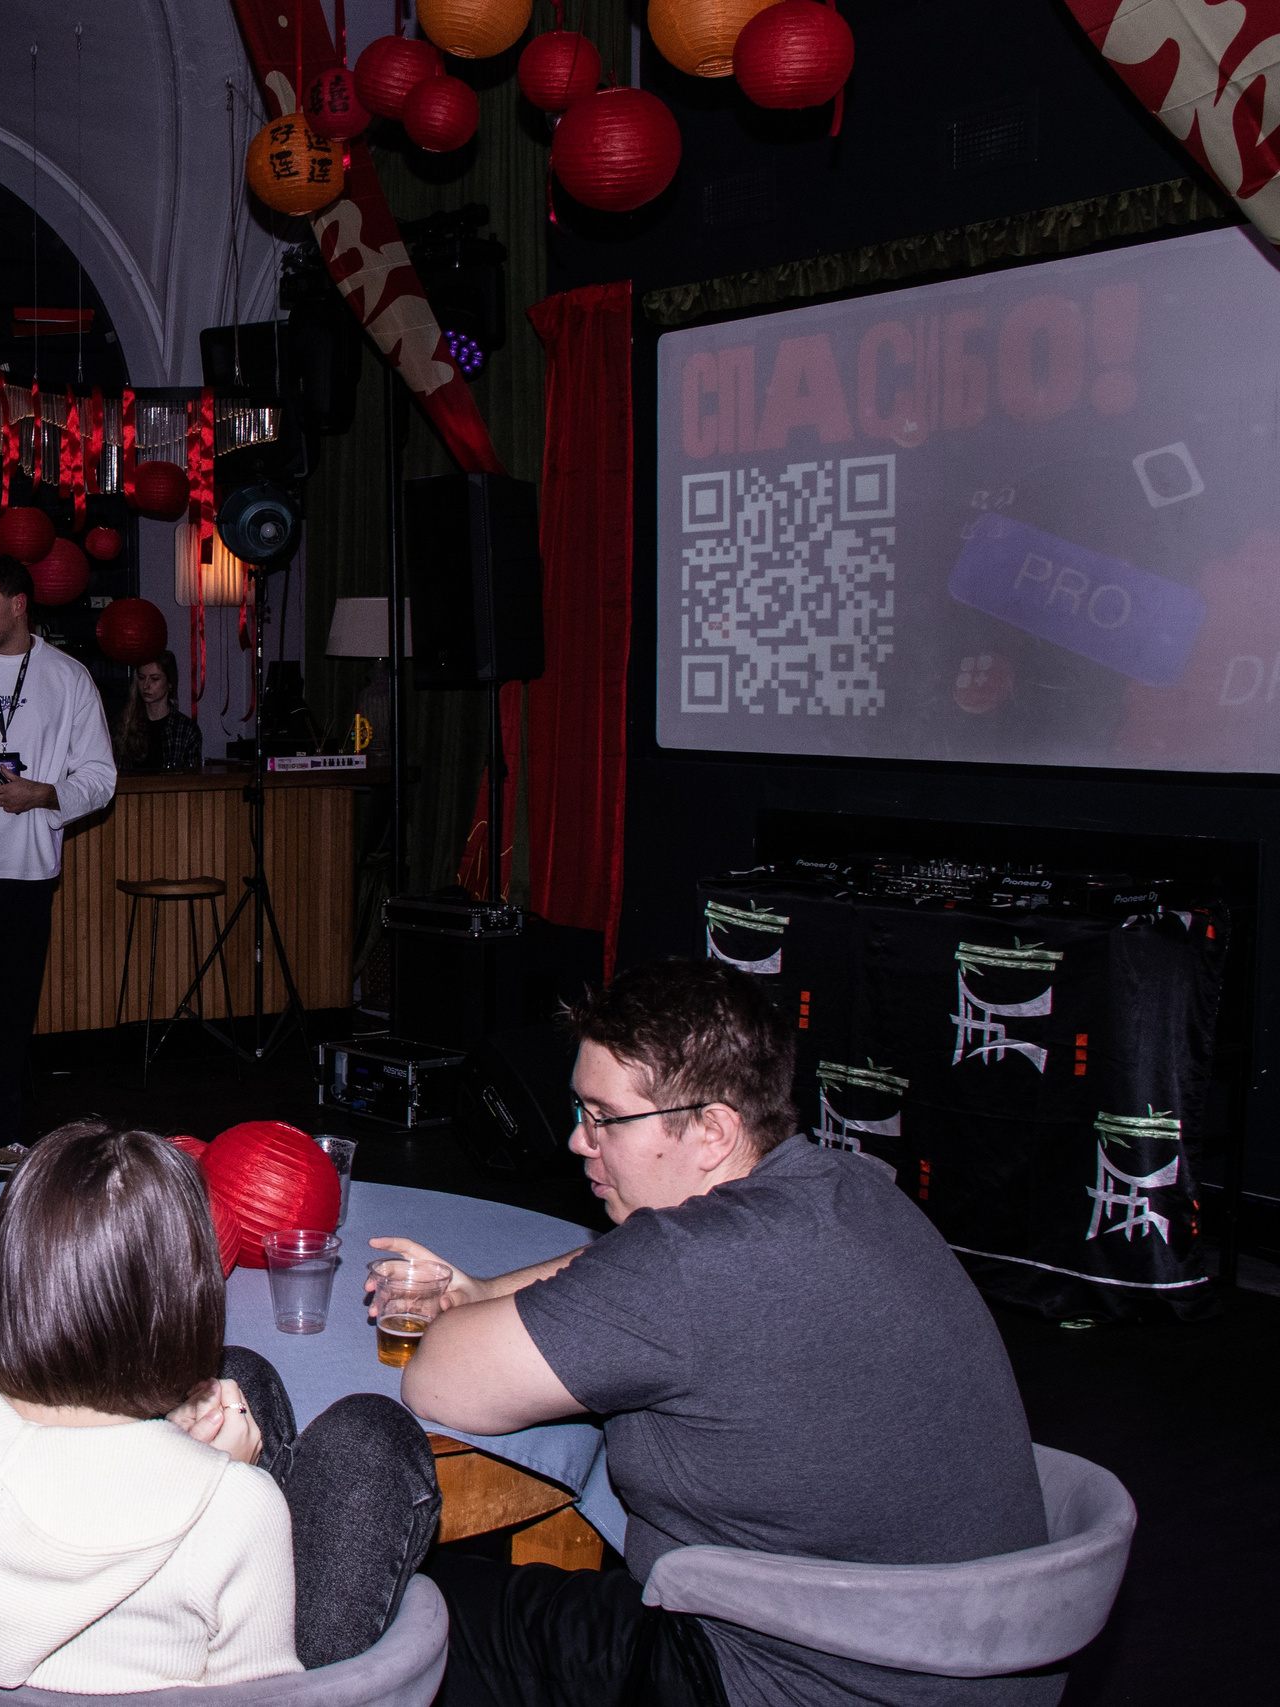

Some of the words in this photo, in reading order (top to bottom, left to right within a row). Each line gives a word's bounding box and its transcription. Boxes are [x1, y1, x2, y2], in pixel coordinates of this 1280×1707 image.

[1013, 551, 1132, 630] PRO
[795, 859, 828, 869] Pioneer
[1001, 877, 1040, 888] Pioneer
[1113, 894, 1147, 904] Pioneer
